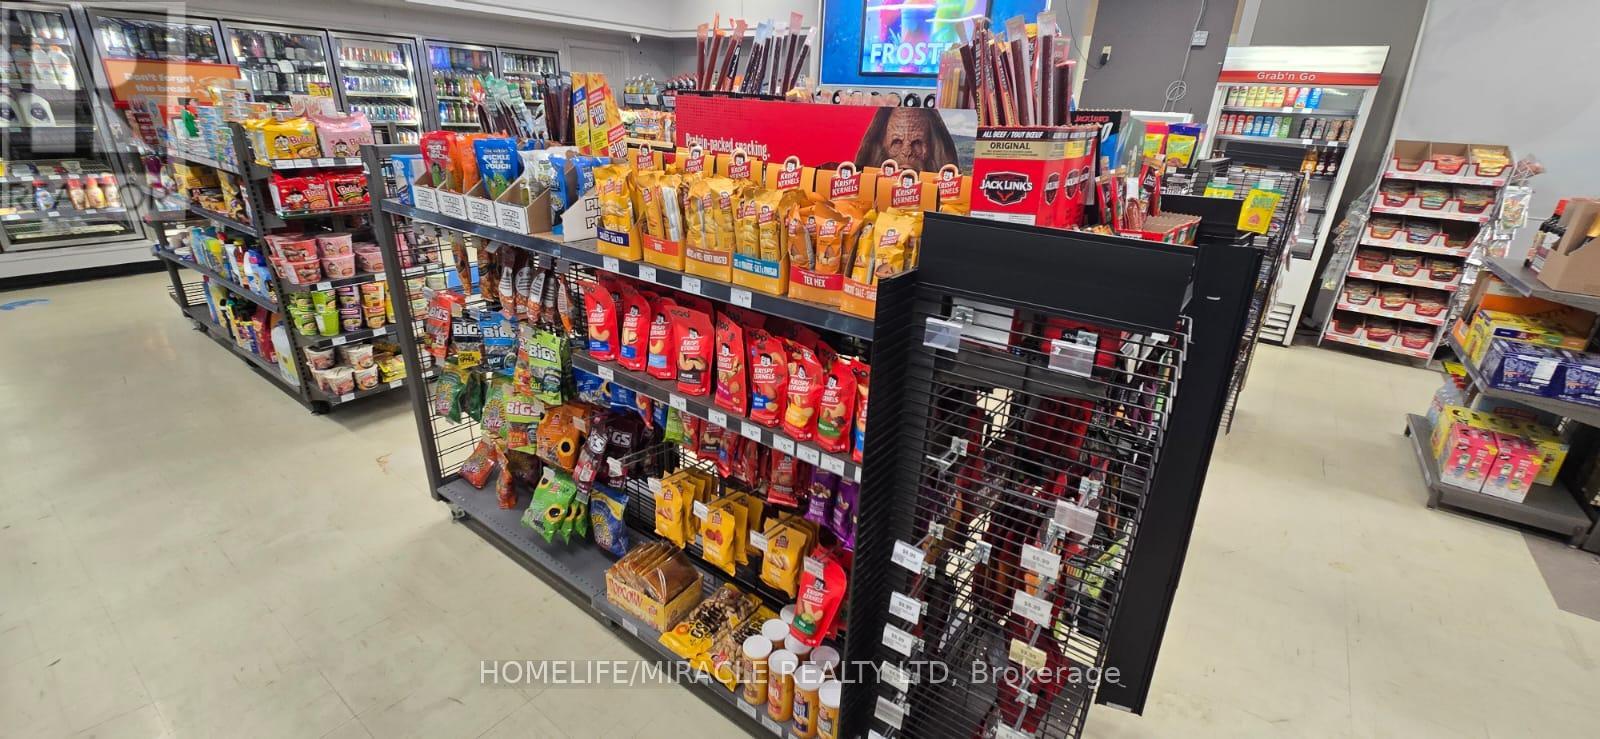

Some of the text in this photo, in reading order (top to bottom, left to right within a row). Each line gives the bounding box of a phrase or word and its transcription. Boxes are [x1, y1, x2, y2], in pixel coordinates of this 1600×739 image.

[870, 42, 954, 66] FROST
[123, 72, 195, 86] Don't forget
[1300, 72, 1316, 81] Go
[136, 84, 156, 92] the
[990, 142, 1031, 150] ORIGINAL
[780, 172, 798, 180] KRISPY
[834, 178, 857, 188] KRISPY
[980, 179, 1004, 191] JACK
[1004, 180, 1033, 192] LINK'S
[832, 185, 858, 196] KERNELS
[895, 188, 918, 198] KRISPY
[893, 195, 919, 205] KERNELS
[803, 275, 826, 288] TEX MEX
